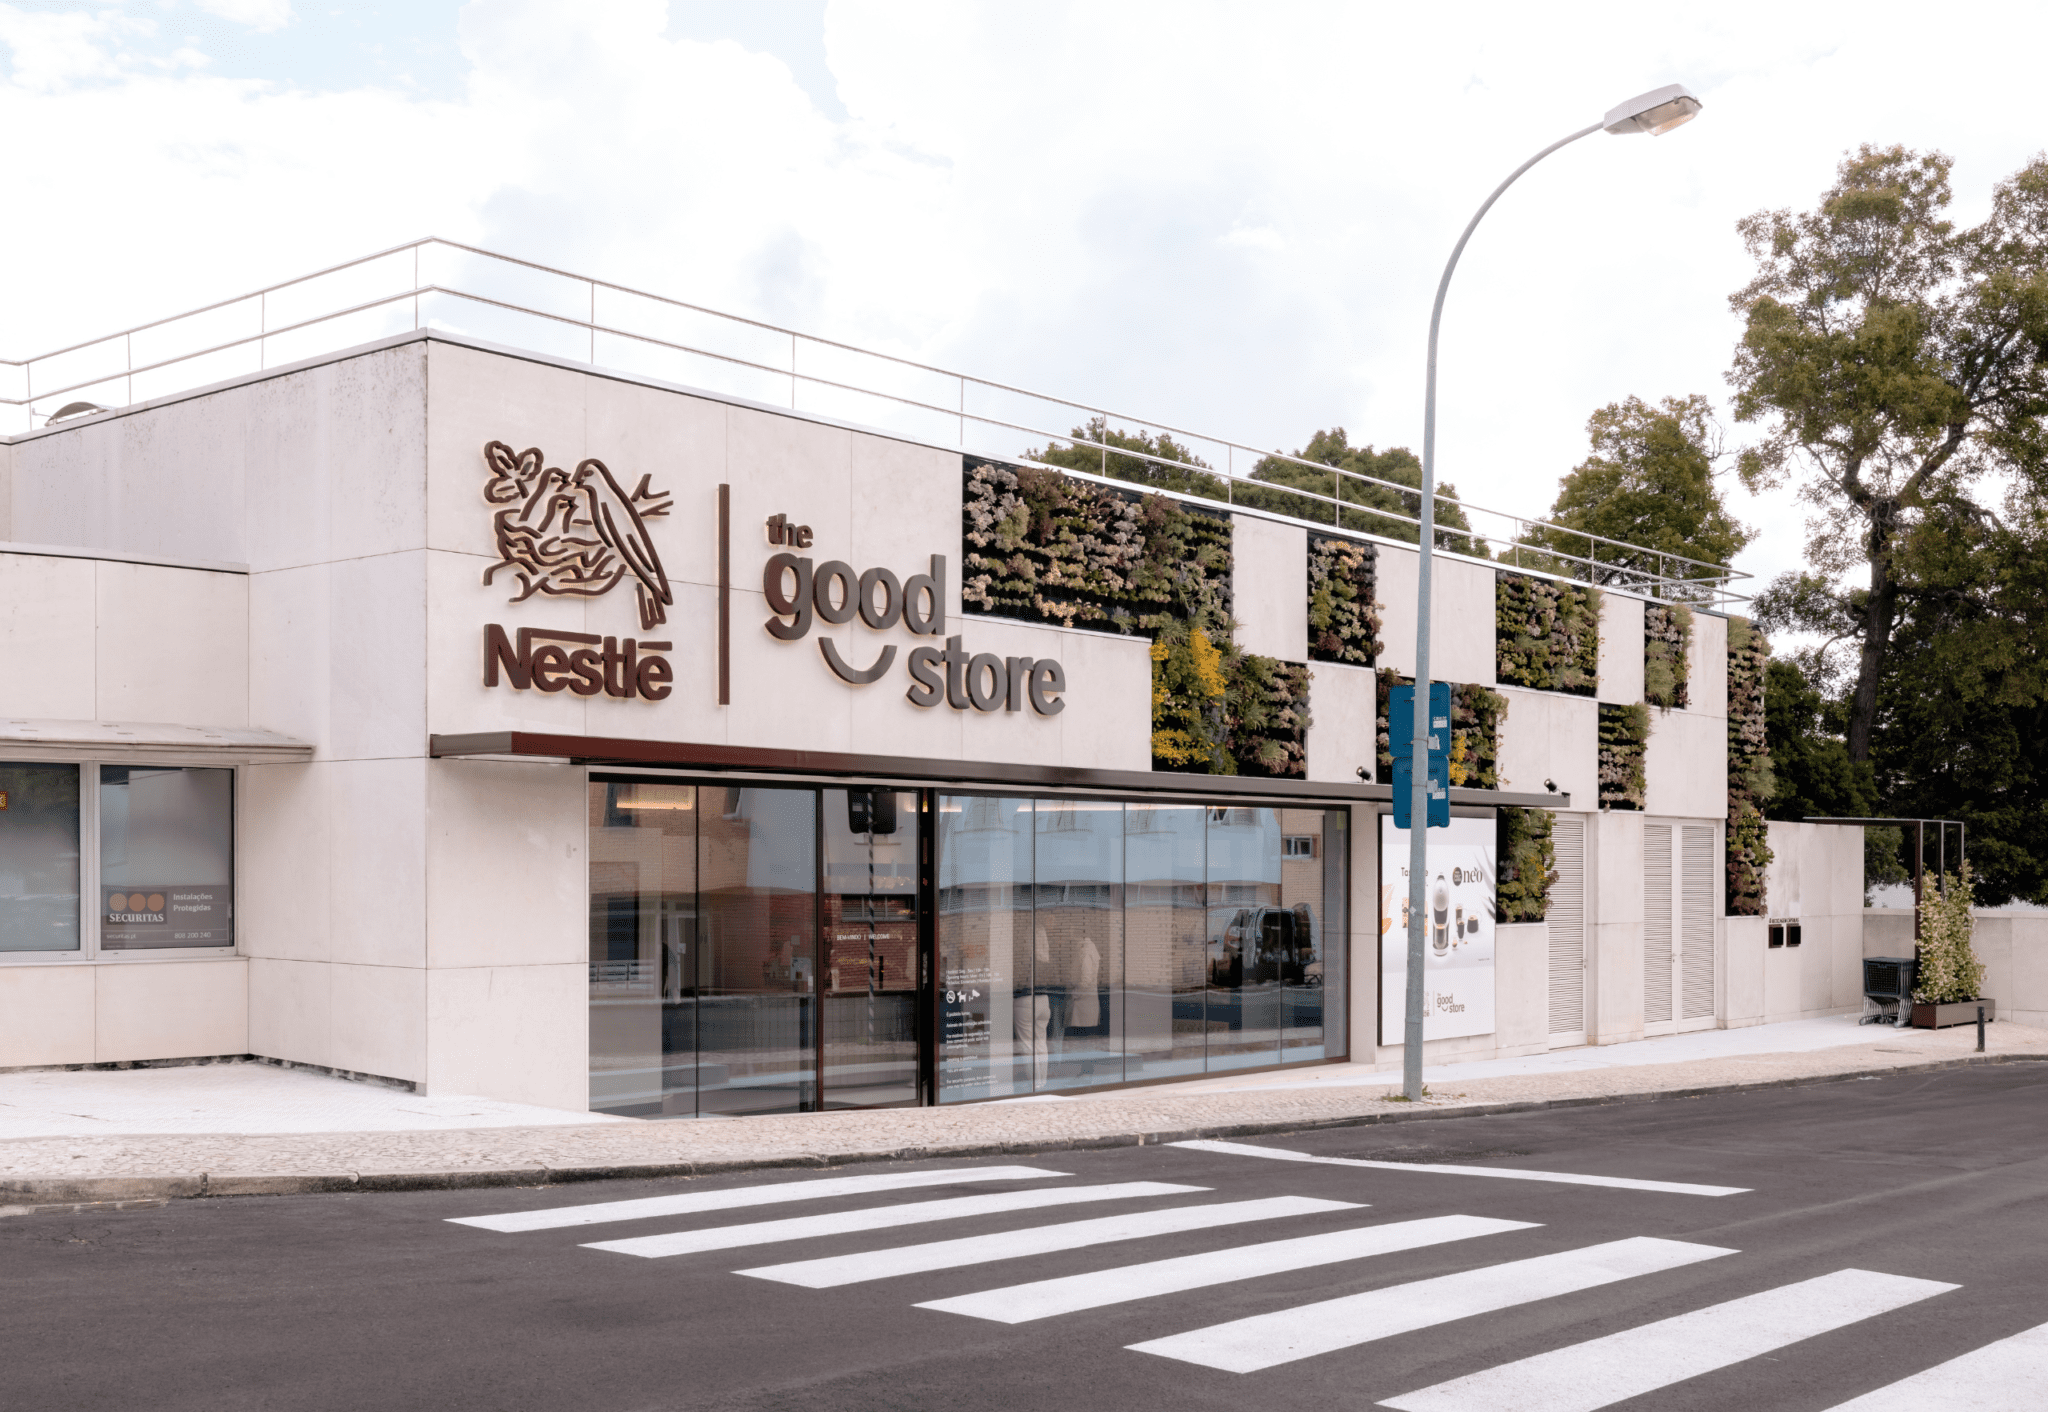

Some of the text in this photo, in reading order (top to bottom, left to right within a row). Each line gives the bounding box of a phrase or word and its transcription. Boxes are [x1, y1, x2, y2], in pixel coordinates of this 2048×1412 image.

[766, 513, 814, 549] the
[763, 553, 946, 641] good
[905, 634, 1066, 716] store
[173, 893, 213, 902] Instalações
[173, 904, 212, 912] Protegidas
[109, 913, 164, 923] SECURITAS
[1436, 993, 1453, 1008] good
[1449, 1003, 1465, 1013] store
